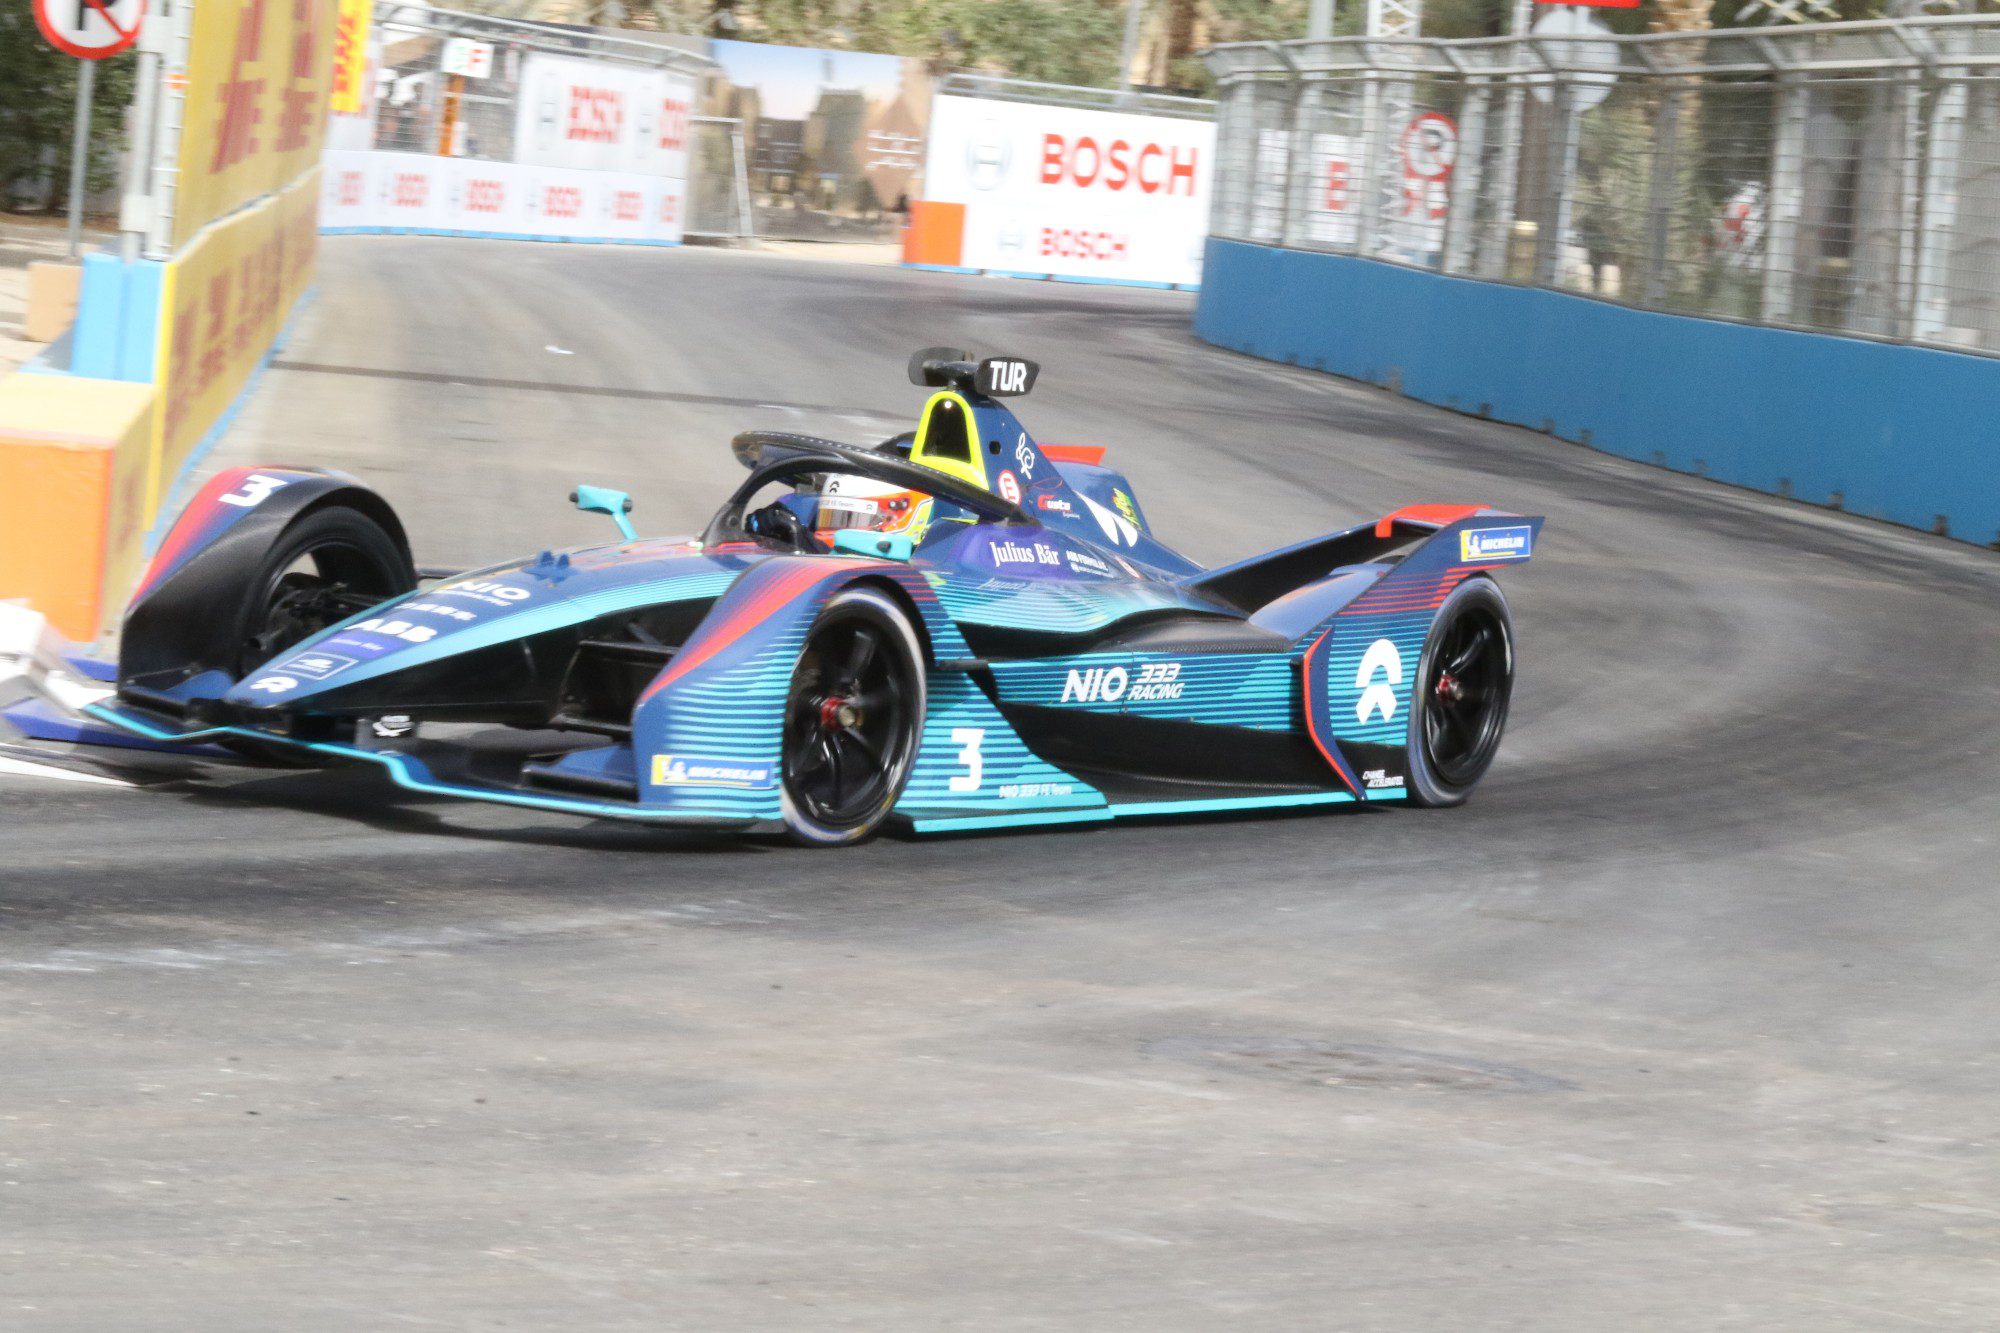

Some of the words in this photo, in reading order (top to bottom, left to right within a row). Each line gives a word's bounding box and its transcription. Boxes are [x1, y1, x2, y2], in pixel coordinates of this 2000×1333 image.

[1040, 133, 1199, 197] BOSCH
[1041, 227, 1129, 261] BOSCH
[989, 360, 1028, 392] TUR
[217, 474, 288, 507] 3
[989, 541, 1035, 568] Julius
[1034, 543, 1061, 566] Bär
[1480, 536, 1525, 551] MICHELIN
[447, 581, 531, 600] NIO
[1060, 666, 1128, 702] NIO
[1136, 663, 1182, 683] 333
[1127, 683, 1186, 700] RACING
[687, 766, 769, 781] MICHELIN
[949, 728, 985, 791] 3
